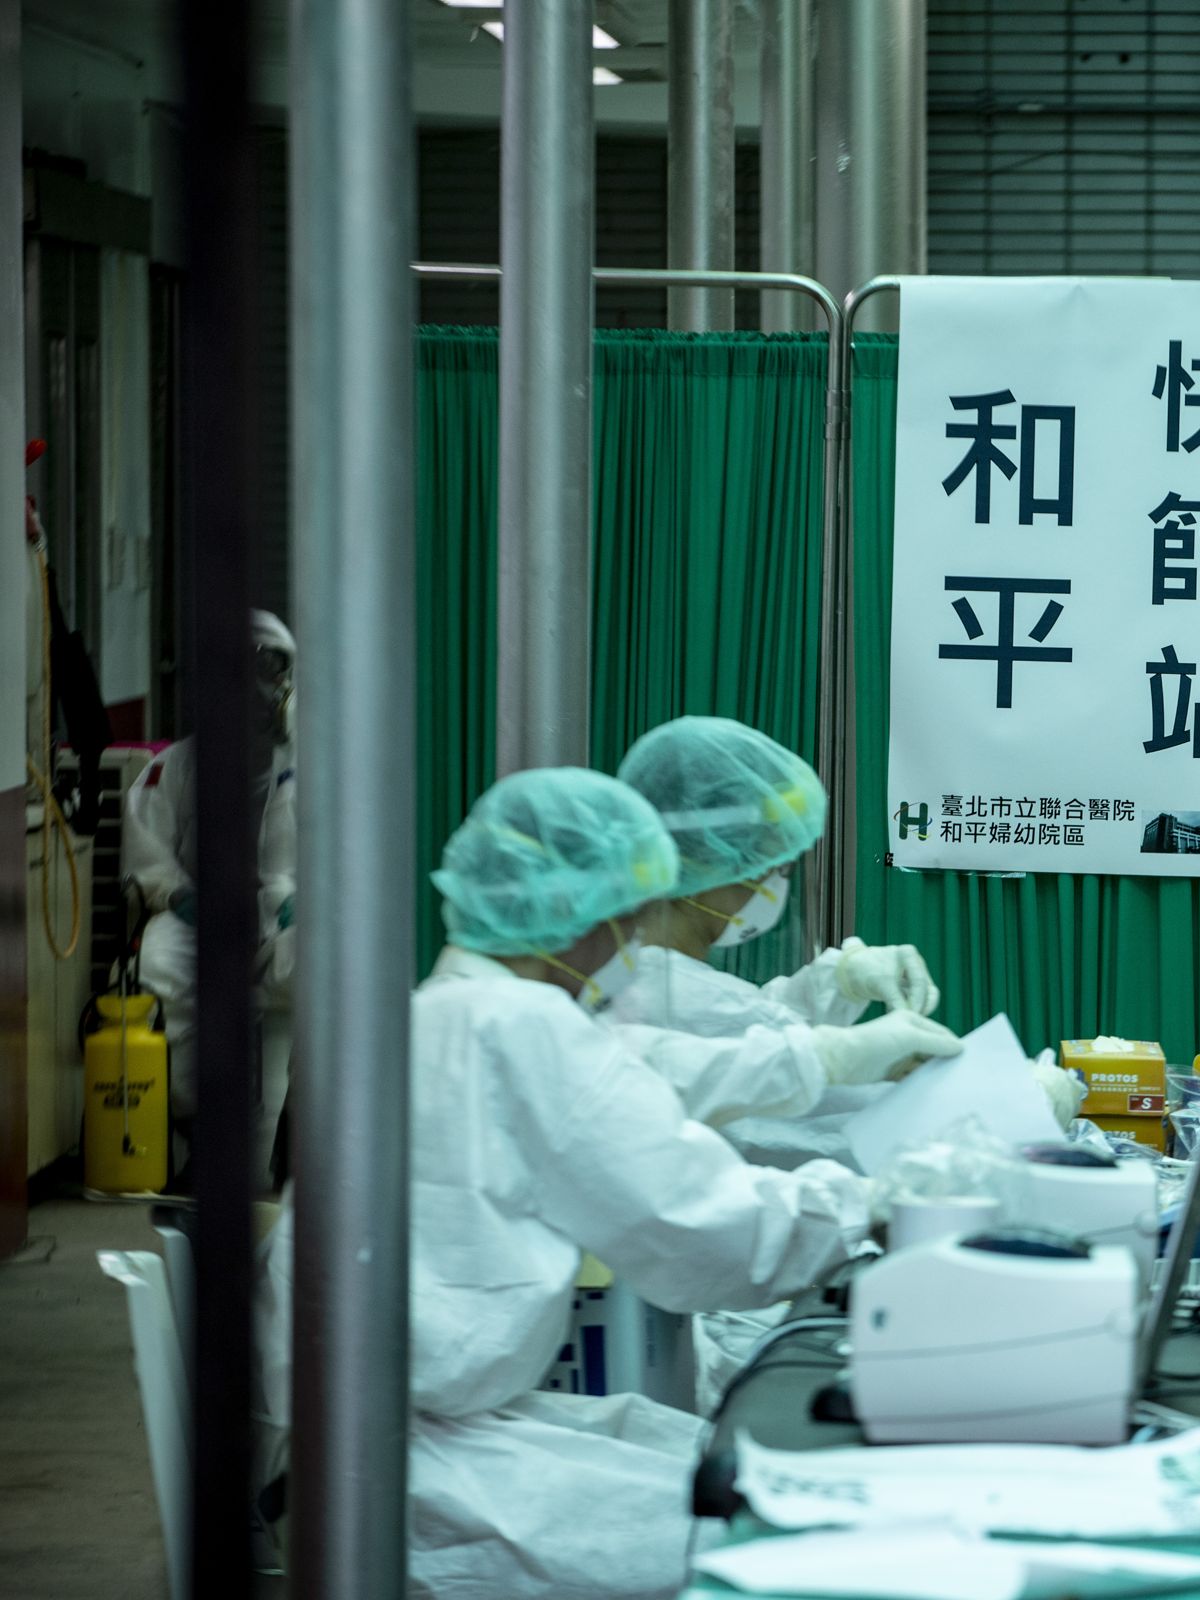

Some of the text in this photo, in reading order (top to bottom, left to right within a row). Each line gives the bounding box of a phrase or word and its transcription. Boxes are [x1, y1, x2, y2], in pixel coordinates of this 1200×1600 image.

[938, 388, 1076, 709] 和平
[940, 794, 1136, 823] 臺北市立聯合醫院
[939, 820, 1086, 847] 和平婦幼院區
[1091, 1073, 1138, 1083] PROTOS
[1141, 1098, 1152, 1110] S
